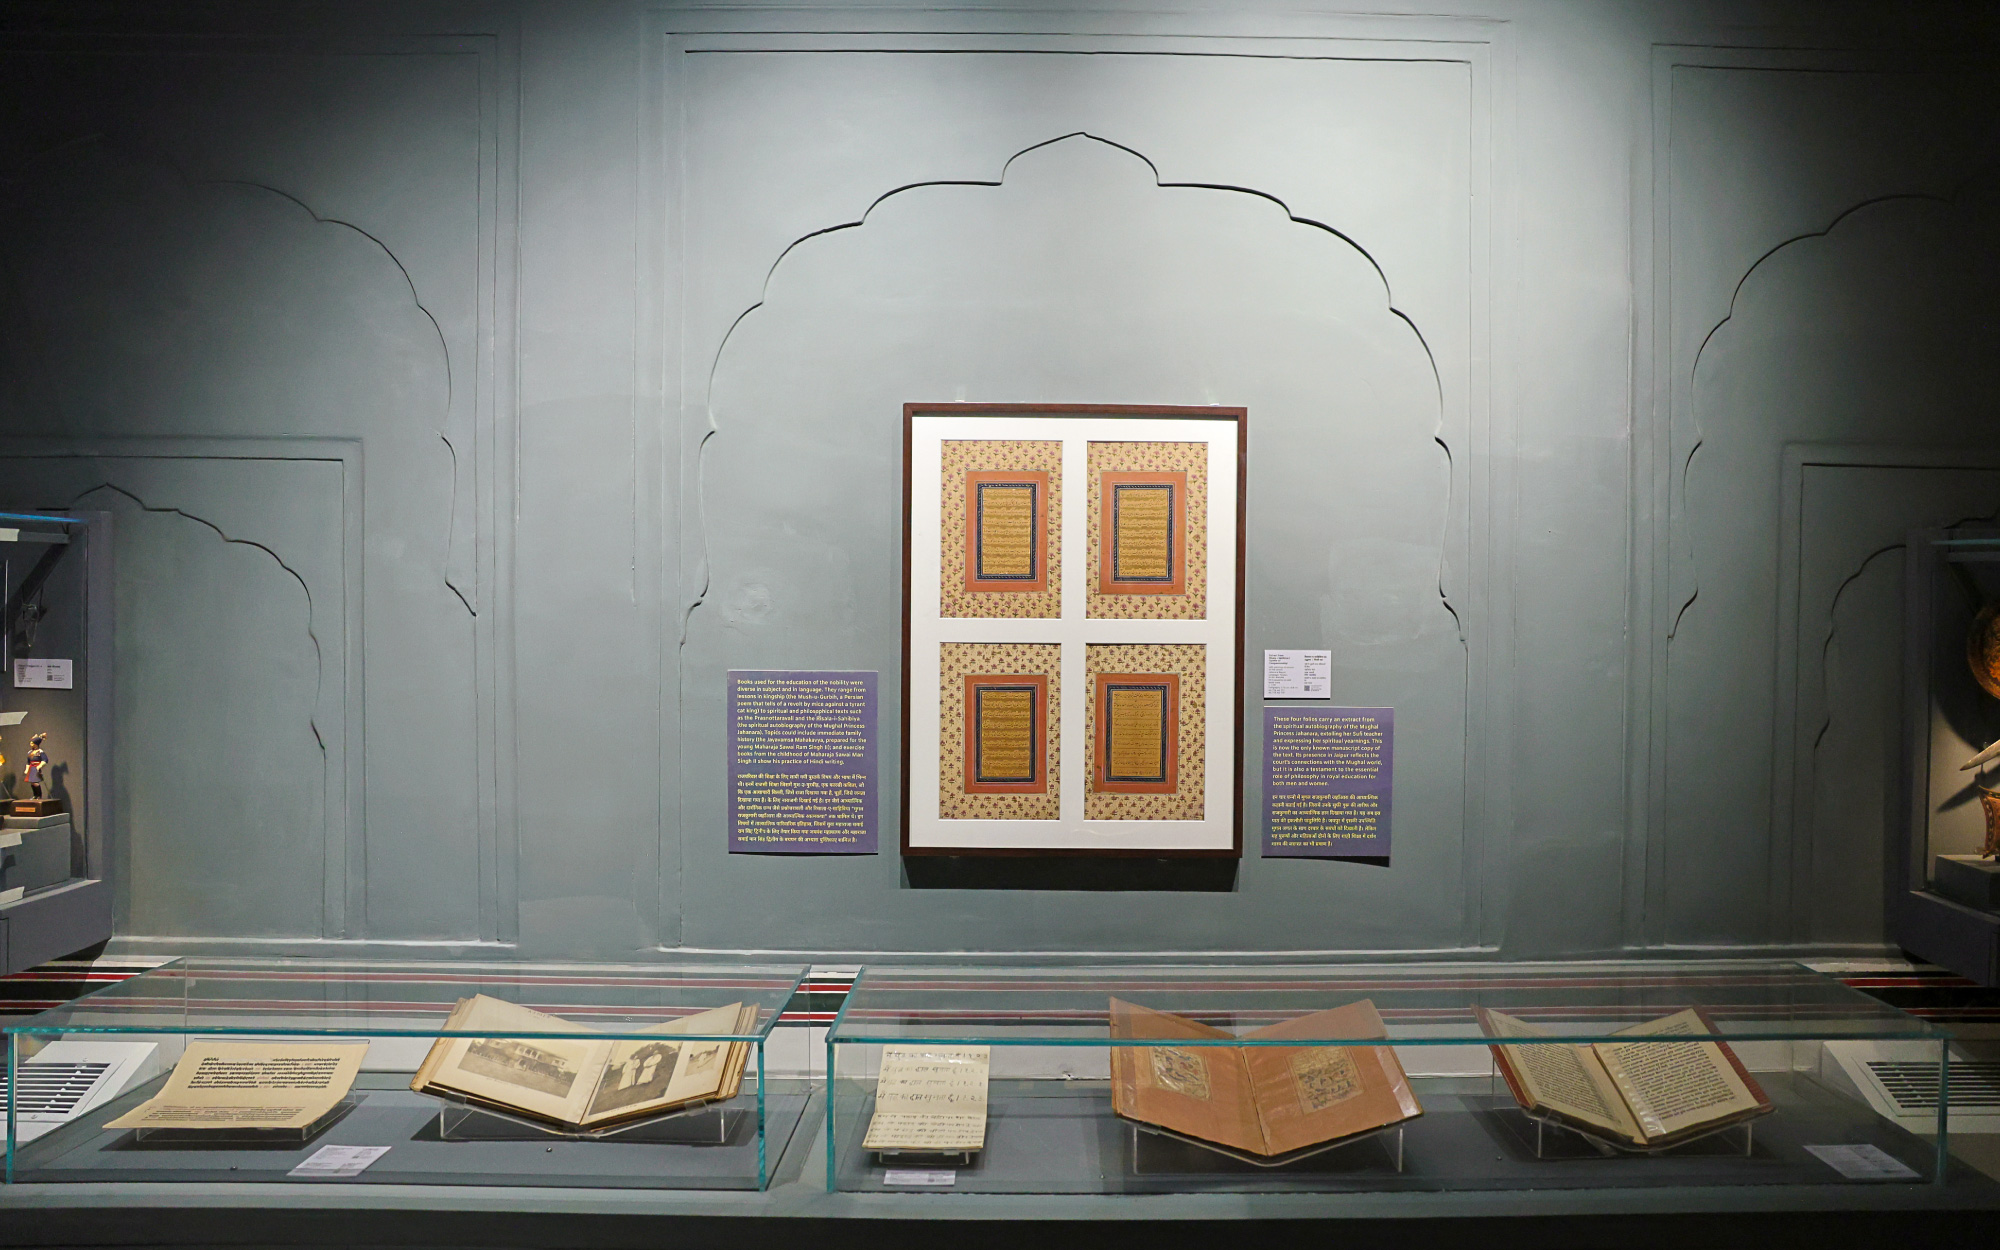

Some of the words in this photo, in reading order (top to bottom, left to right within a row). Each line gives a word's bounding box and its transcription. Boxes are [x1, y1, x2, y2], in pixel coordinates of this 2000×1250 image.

[763, 693, 785, 701] kingship
[786, 693, 796, 701] (the
[825, 700, 844, 708] against
[850, 700, 865, 708] tyrant
[765, 729, 781, 737] Topics
[846, 729, 861, 737] family
[737, 736, 754, 744] history
[756, 736, 766, 744] (the
[826, 736, 848, 744] prepared
[1284, 737, 1311, 745] expressing
[1323, 737, 1343, 745] spiritual
